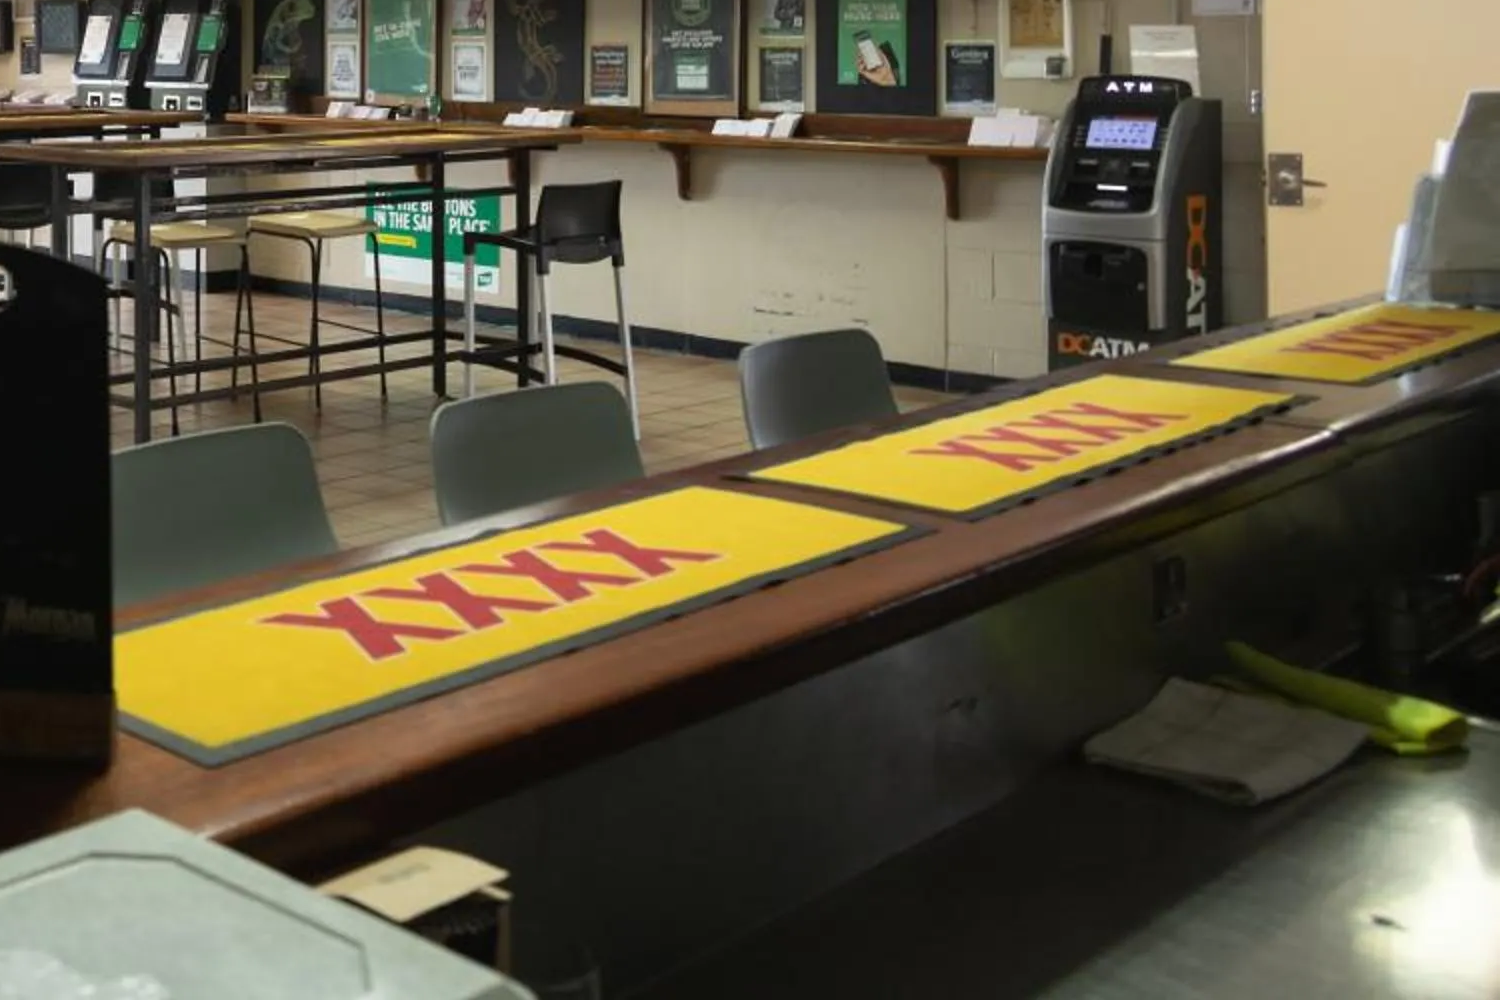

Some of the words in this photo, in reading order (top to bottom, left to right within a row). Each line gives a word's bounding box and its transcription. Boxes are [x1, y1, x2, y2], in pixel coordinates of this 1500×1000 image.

[1106, 81, 1153, 93] ATM
[388, 212, 410, 230] THE
[1186, 195, 1206, 334] DCAT
[1282, 320, 1473, 361] XXXX
[908, 402, 1190, 474] XXXX
[256, 528, 724, 661] XXXX
